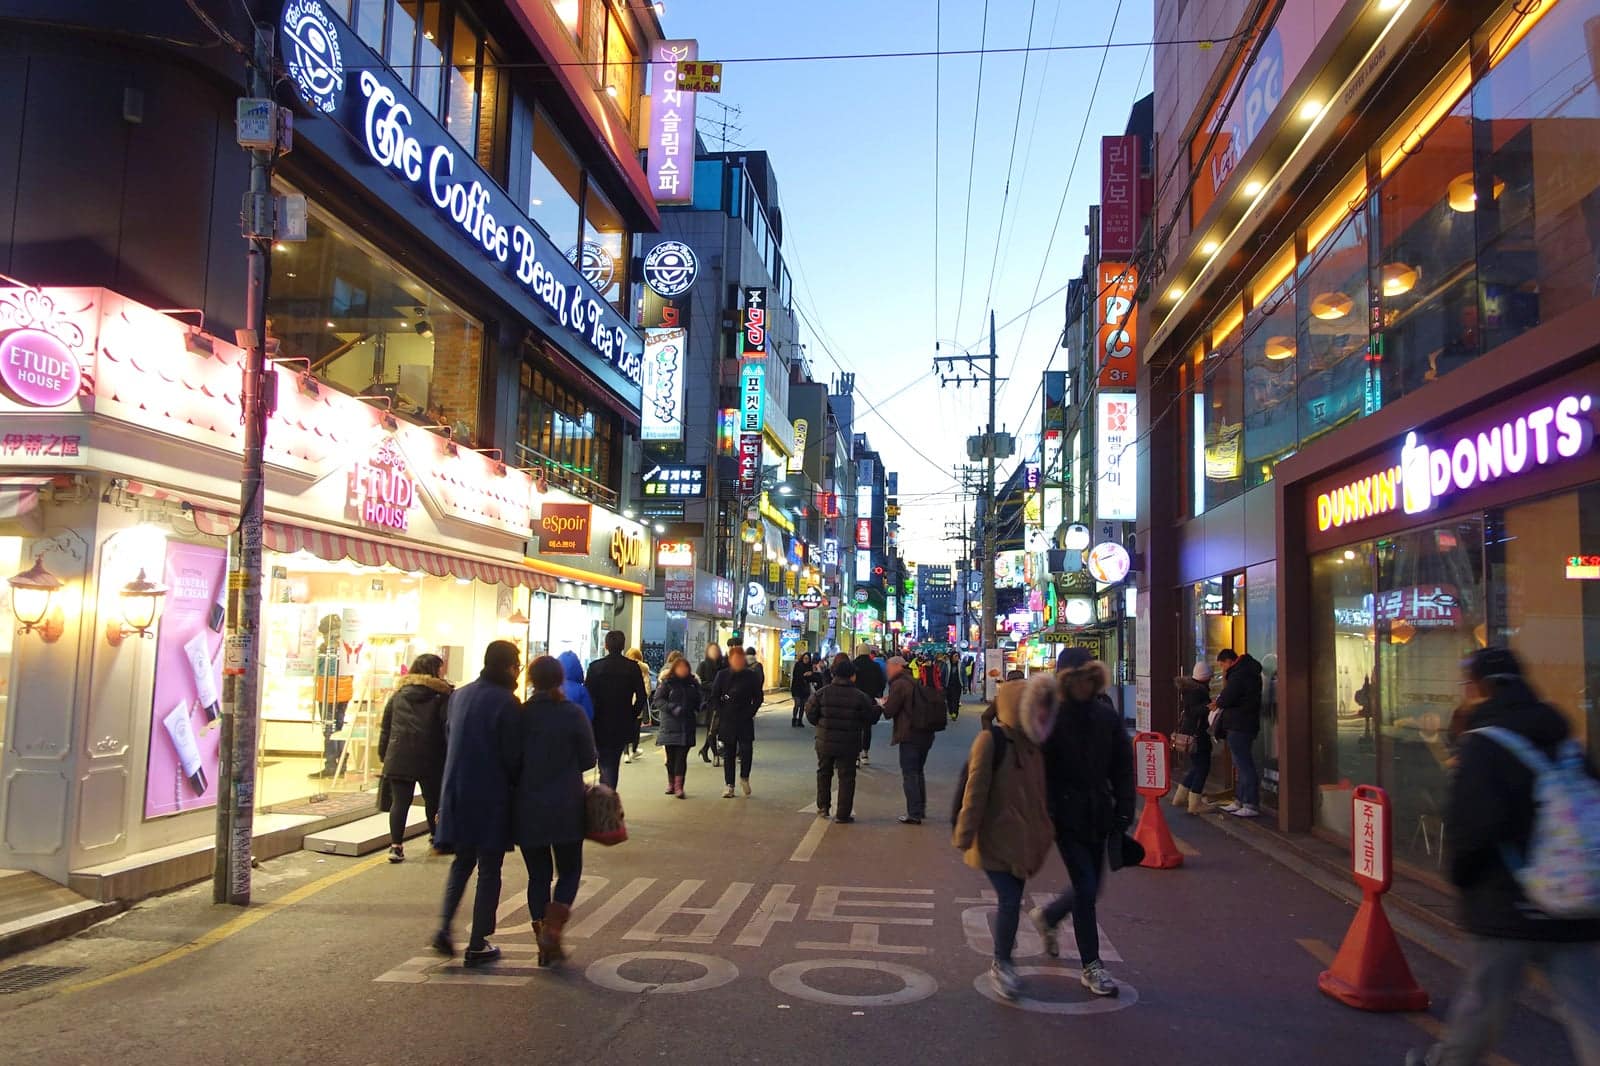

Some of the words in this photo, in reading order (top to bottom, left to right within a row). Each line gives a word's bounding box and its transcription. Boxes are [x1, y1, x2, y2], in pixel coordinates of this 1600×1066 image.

[360, 69, 423, 182] The
[428, 145, 510, 263] Coffee
[513, 224, 567, 328] Bean
[570, 284, 586, 335] &
[587, 298, 614, 361] Tea
[10, 345, 71, 380] ETUDE
[18, 369, 61, 391] HOUSE
[1109, 369, 1129, 381] 3F
[3, 433, 81, 457] 伊蒂之屋
[366, 501, 408, 529] HOUSE
[1317, 465, 1401, 531] DUNKIN'
[542, 515, 586, 535] espoir
[611, 527, 641, 576] espoir
[1145, 742, 1157, 788] 주차금지
[1362, 803, 1375, 877] 주차금지
